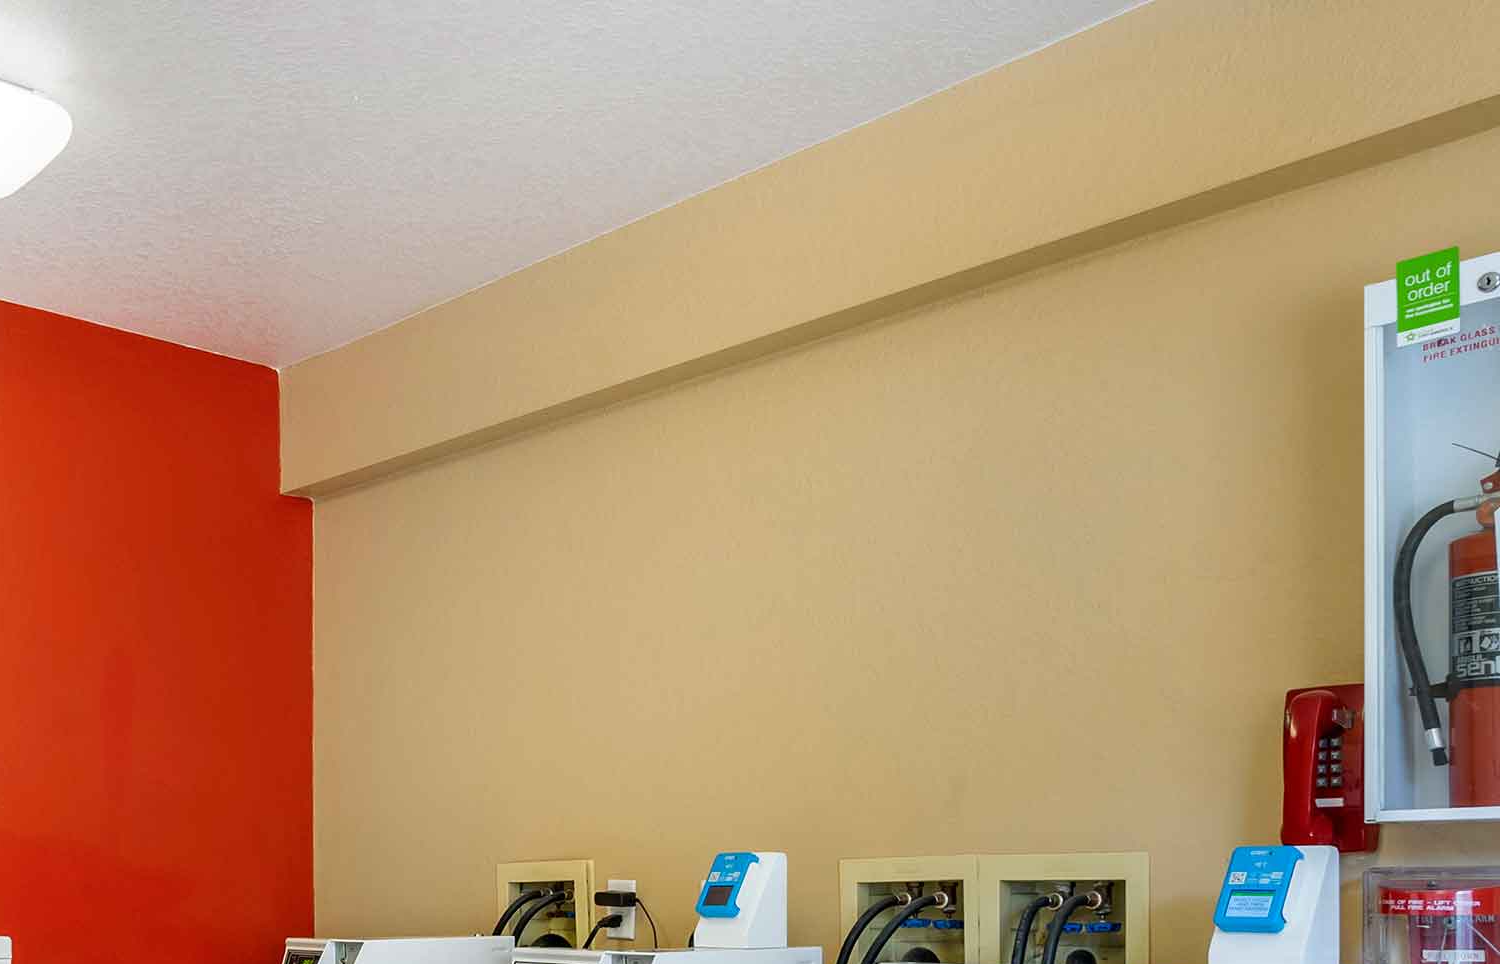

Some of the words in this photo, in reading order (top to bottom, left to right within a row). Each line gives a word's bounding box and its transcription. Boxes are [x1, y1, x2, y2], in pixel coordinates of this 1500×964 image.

[1405, 269, 1430, 286] out
[1436, 261, 1452, 278] of
[1407, 280, 1450, 301] order
[1422, 336, 1457, 352] BREAK
[1460, 326, 1496, 342] GLASS
[1423, 350, 1445, 363] FIRE
